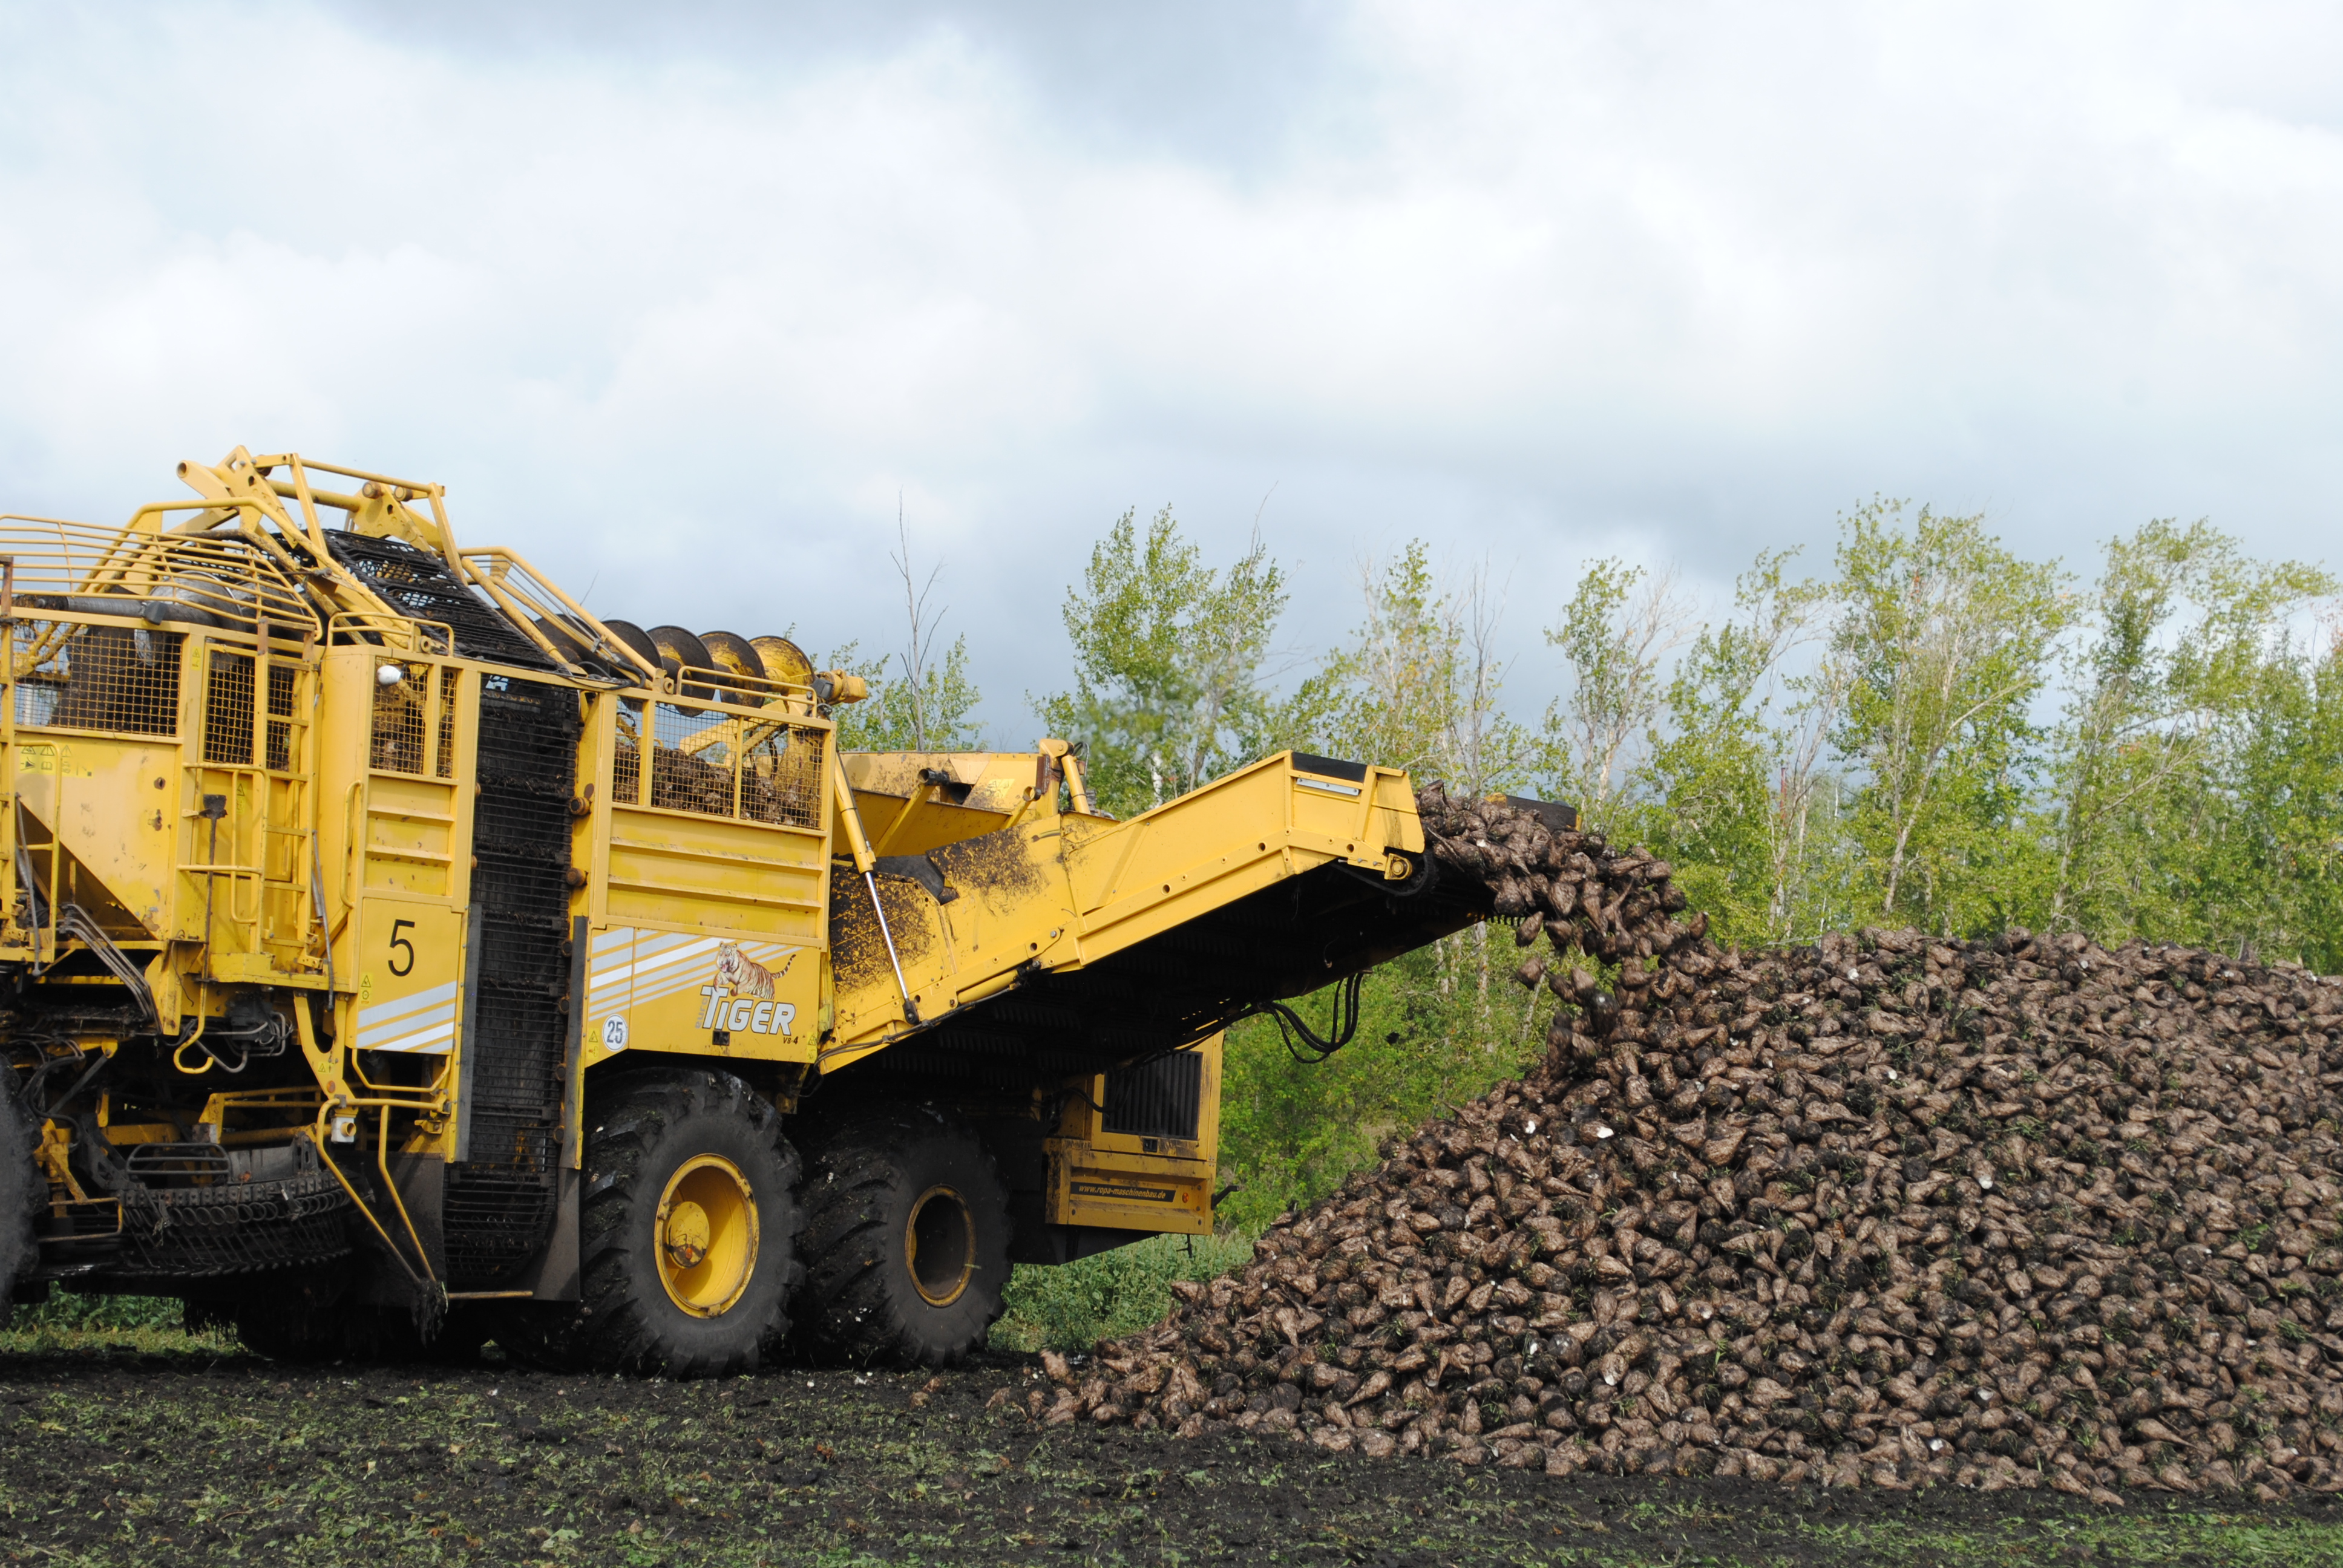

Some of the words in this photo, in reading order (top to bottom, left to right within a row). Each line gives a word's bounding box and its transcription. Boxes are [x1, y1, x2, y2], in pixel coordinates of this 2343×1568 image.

[388, 919, 415, 976] 5
[695, 997, 709, 1028] euro
[607, 1020, 623, 1044] 25
[1079, 1185, 1165, 1199] www.ropa-maschinenbau.de
